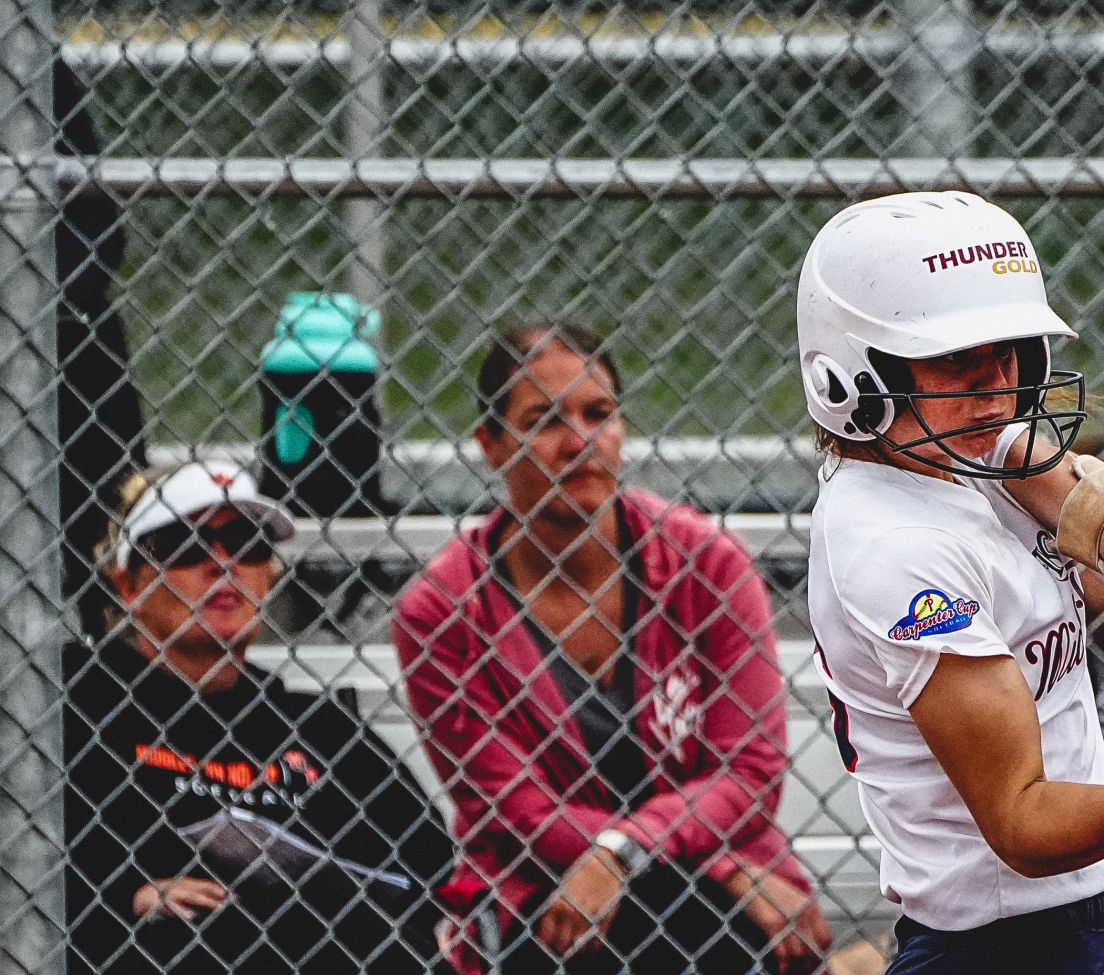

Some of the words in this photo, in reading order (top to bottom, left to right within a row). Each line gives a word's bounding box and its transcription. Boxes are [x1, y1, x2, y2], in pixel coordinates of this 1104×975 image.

[922, 241, 1028, 273] THUNDER
[991, 259, 1038, 275] GOLD
[890, 608, 955, 641] Carpenter
[954, 599, 978, 618] Cup
